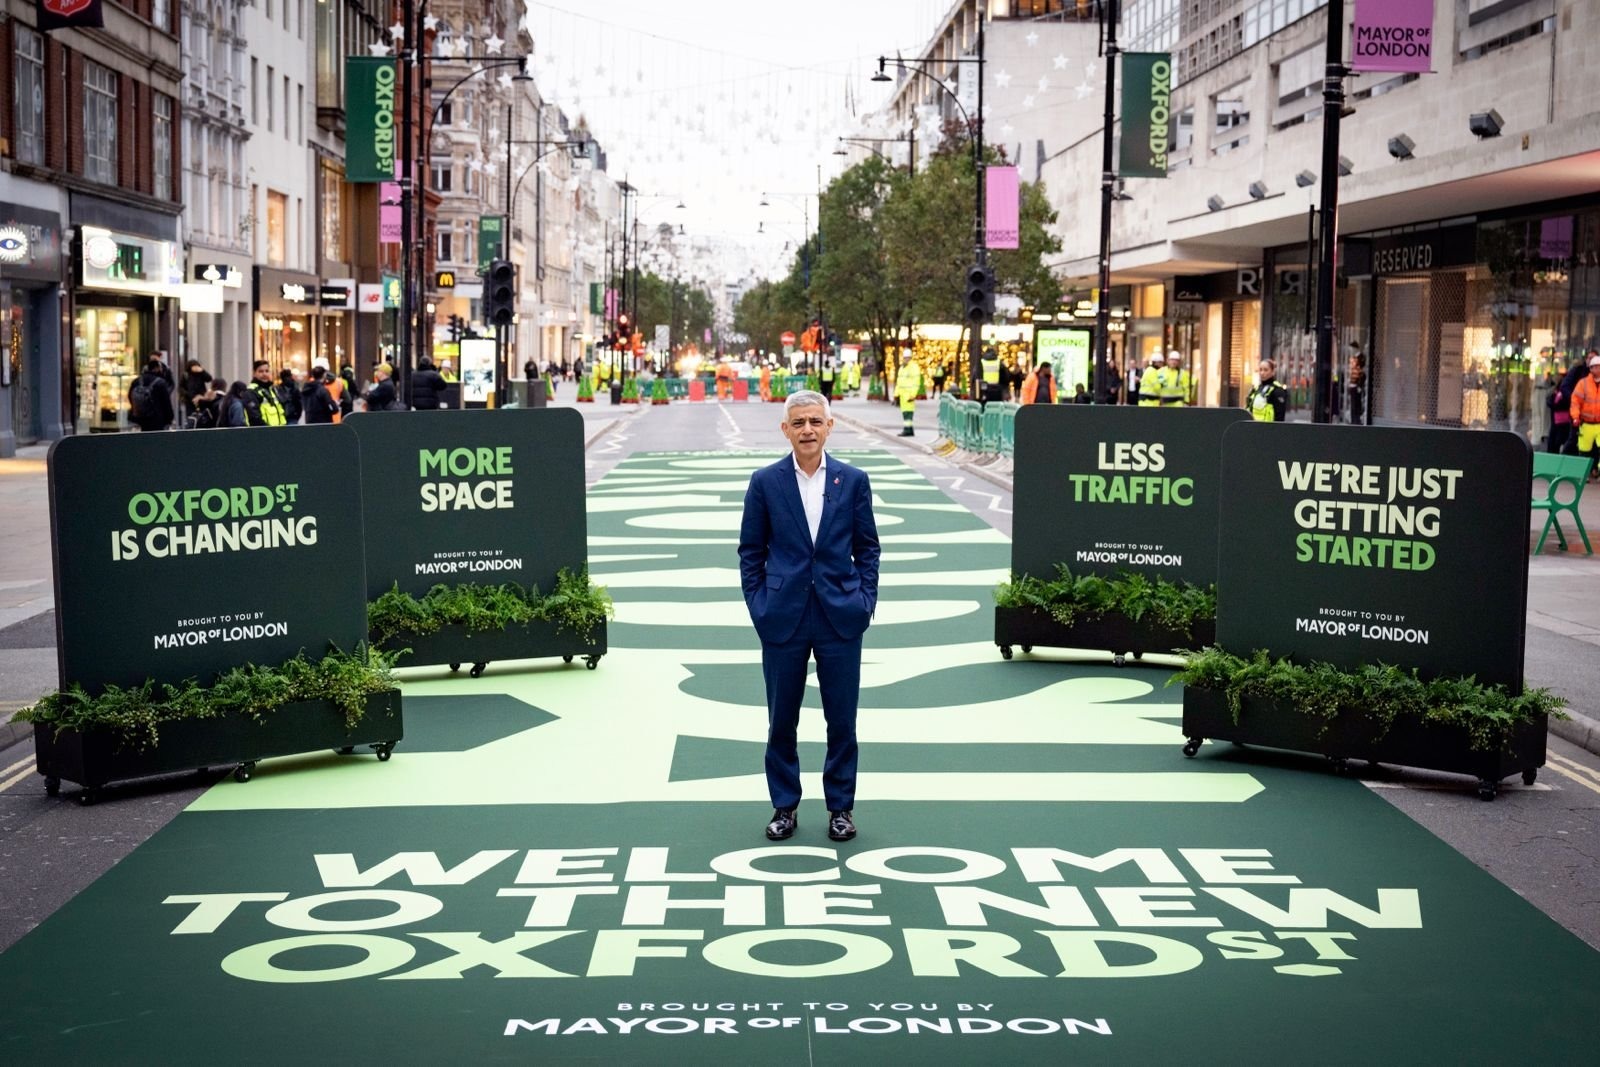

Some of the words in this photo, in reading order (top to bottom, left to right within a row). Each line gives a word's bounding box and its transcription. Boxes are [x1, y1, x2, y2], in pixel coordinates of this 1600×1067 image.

[1358, 27, 1414, 41] MAYOR
[1416, 28, 1430, 37] OF
[1357, 42, 1430, 57] LONDON
[374, 65, 395, 158] OXFORD
[1150, 61, 1170, 154] OXFORD
[1373, 244, 1432, 273] RESERVED
[1041, 338, 1085, 347] COMING
[419, 447, 513, 477] MORE
[1098, 442, 1165, 472] LESS
[420, 480, 514, 512] SPACE
[1069, 474, 1194, 506] TRAFFIC
[1278, 460, 1381, 495] WE'RE
[1387, 466, 1463, 504] JUST
[128, 486, 275, 525] OXFORD
[275, 483, 298, 505] ST
[1294, 498, 1440, 537] GETTING
[111, 529, 140, 561] IS
[145, 516, 317, 558] CHANGING
[1296, 532, 1436, 571] STARTED
[415, 562, 457, 575] MAYOR
[458, 561, 468, 569] OF
[469, 558, 522, 572] LONDON
[1076, 551, 1117, 563] MAYOR
[1129, 553, 1182, 566] LONDON
[177, 616, 217, 627] BROUGHT
[220, 615, 231, 623] TO
[234, 613, 252, 621] YOU
[254, 611, 264, 620] BY
[1319, 608, 1357, 618] BROUGHT
[1360, 611, 1372, 619] TO
[1375, 613, 1392, 621] YOU
[154, 630, 208, 649] MAYOR
[208, 629, 221, 639] OF
[222, 622, 288, 642] LONDON
[1296, 618, 1346, 636] MAYOR
[1348, 623, 1360, 632] OF
[1361, 625, 1429, 644] LONDON
[313, 846, 1303, 887] WELCOME
[161, 888, 443, 935] TO
[496, 884, 892, 928] THE
[934, 885, 1423, 929] NEW
[221, 928, 1204, 984] OXFORD
[1205, 930, 1358, 963] ST
[617, 1003, 784, 1012] BROUGHT
[802, 1003, 849, 1012] TO
[868, 1003, 938, 1012] YOU
[956, 1003, 995, 1012] BY
[503, 1016, 740, 1037] MAYOR
[746, 1016, 801, 1029] OF
[814, 1016, 1113, 1036] LONDON
